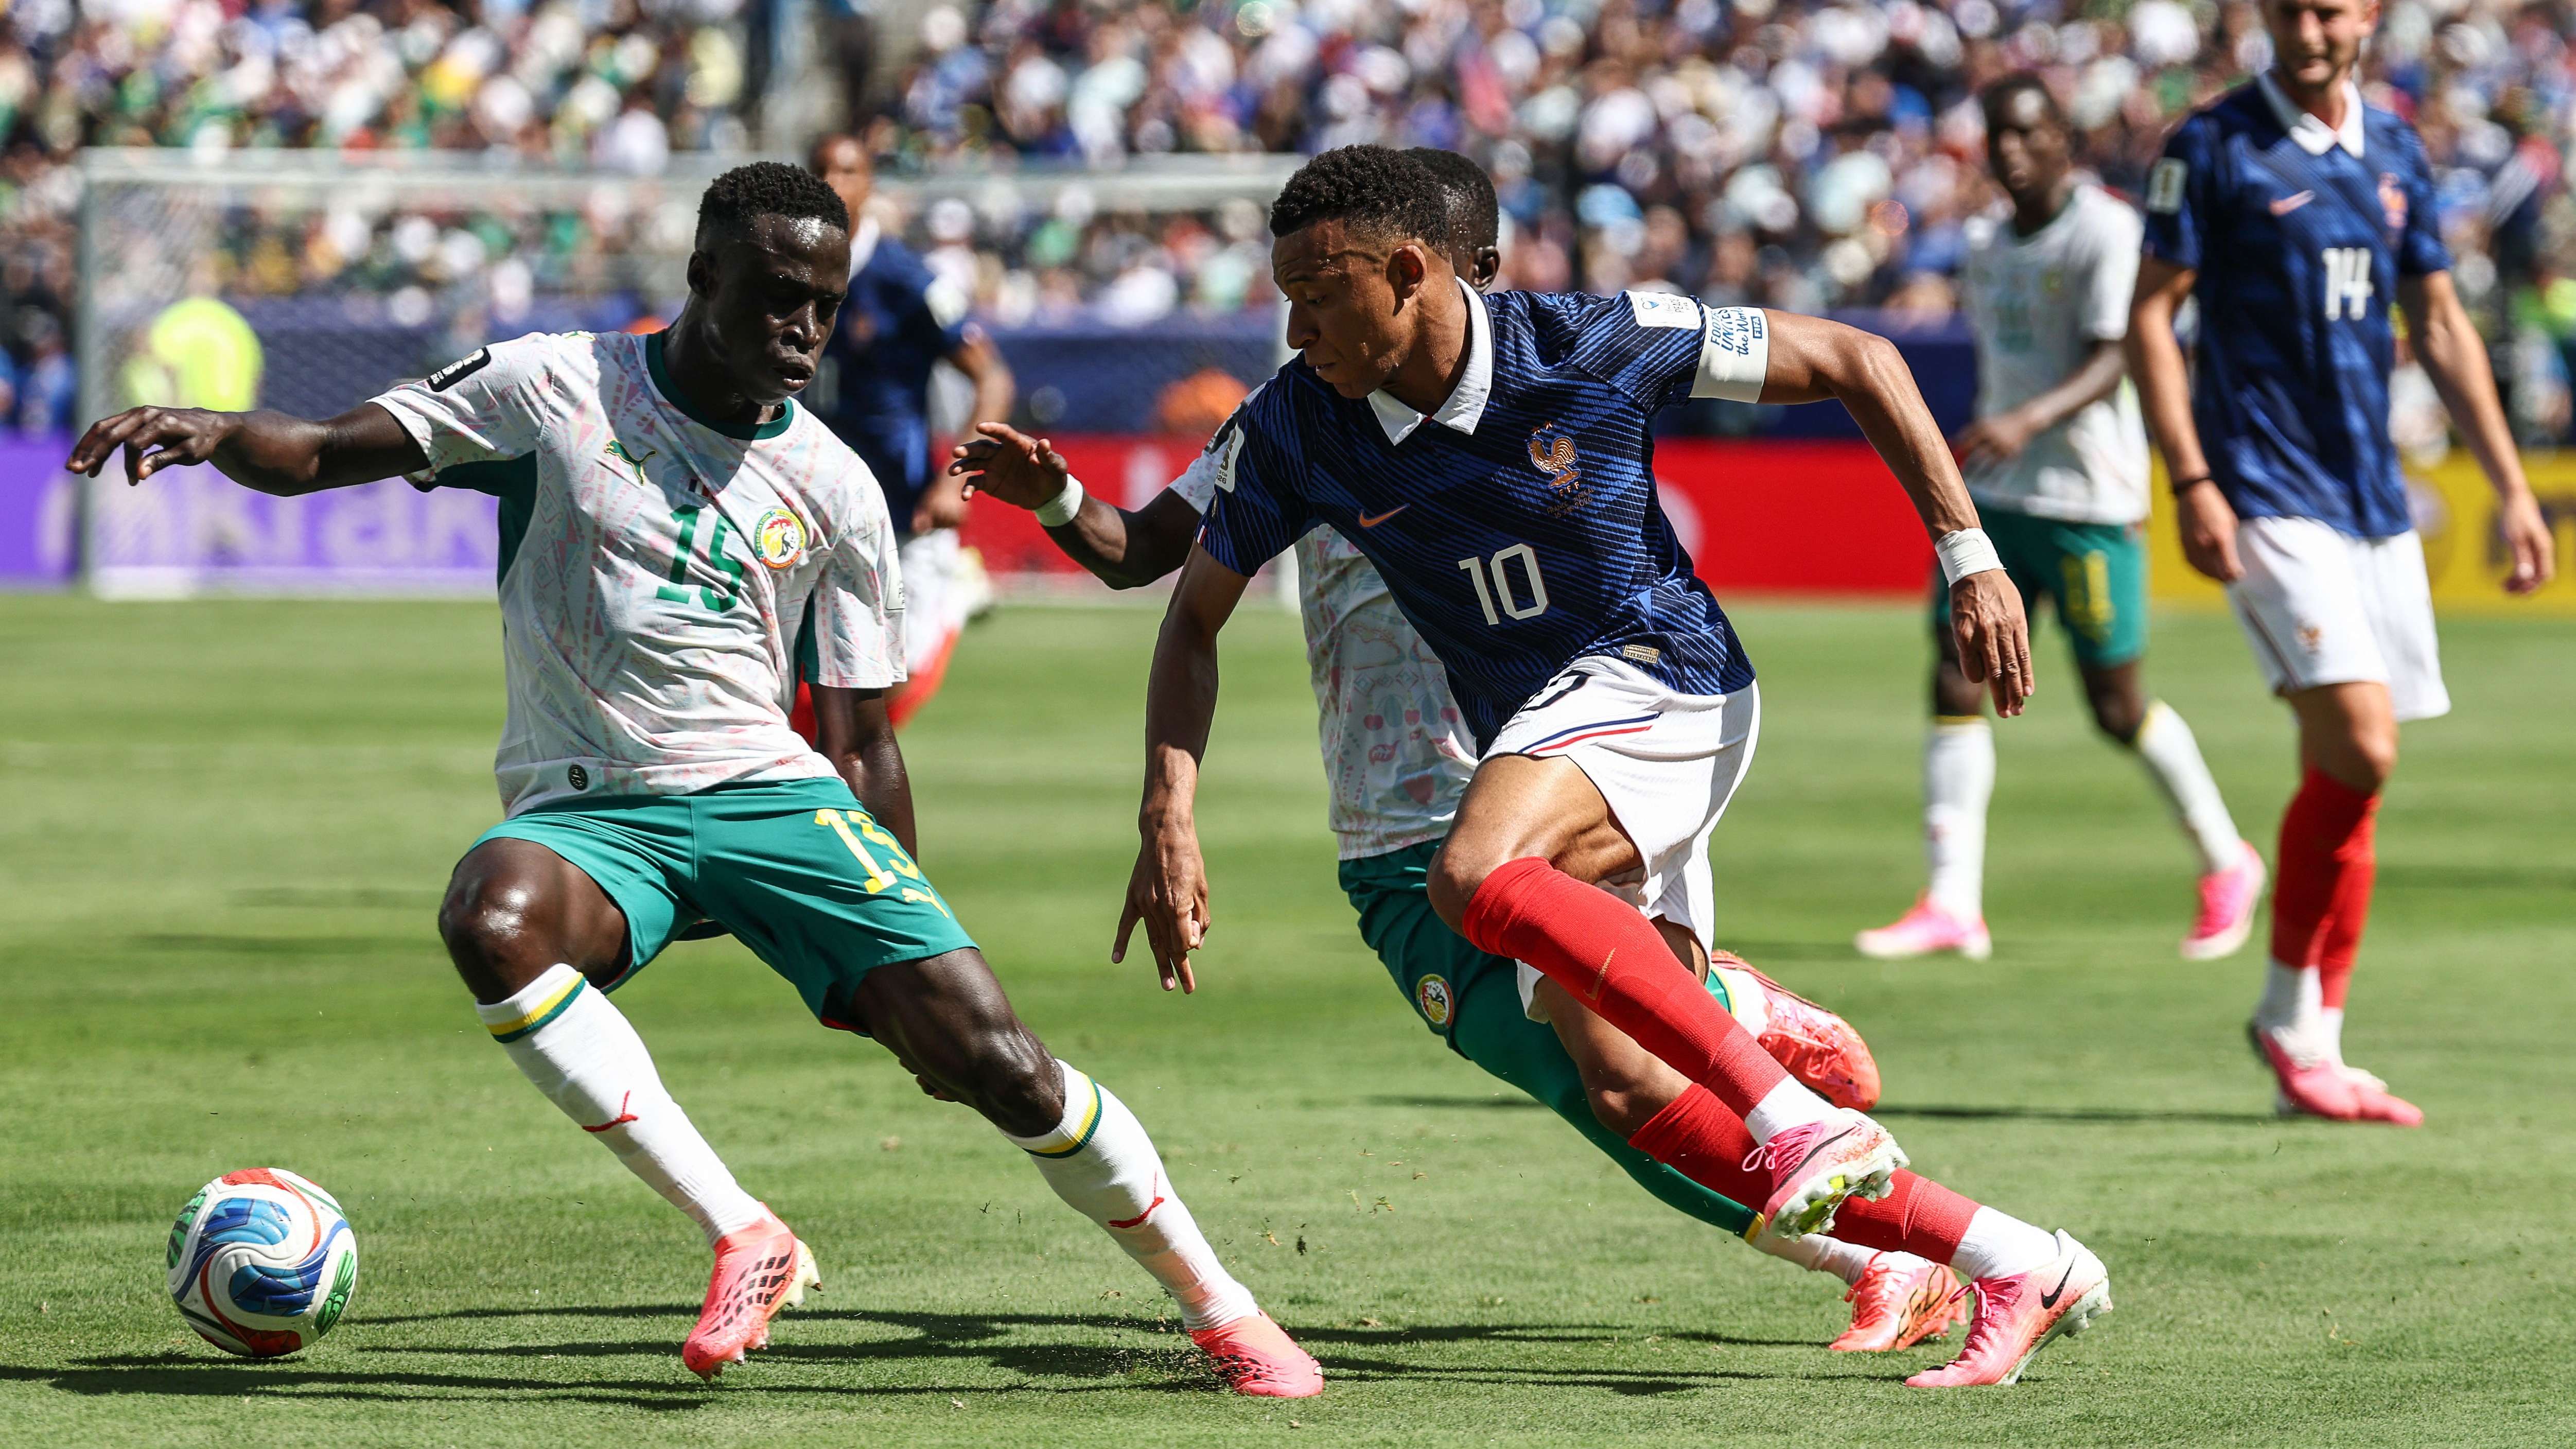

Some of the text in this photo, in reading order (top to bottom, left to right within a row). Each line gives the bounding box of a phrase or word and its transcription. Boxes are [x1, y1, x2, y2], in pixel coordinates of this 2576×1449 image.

[2322, 247, 2374, 321] 14
[1718, 309, 1734, 351] UNITES
[1736, 335, 1749, 357] the
[1751, 317, 1761, 338] FIFA
[1216, 474, 1226, 484] 26
[656, 504, 745, 613] 15
[1458, 543, 1550, 625] 10
[814, 809, 919, 894] 15
